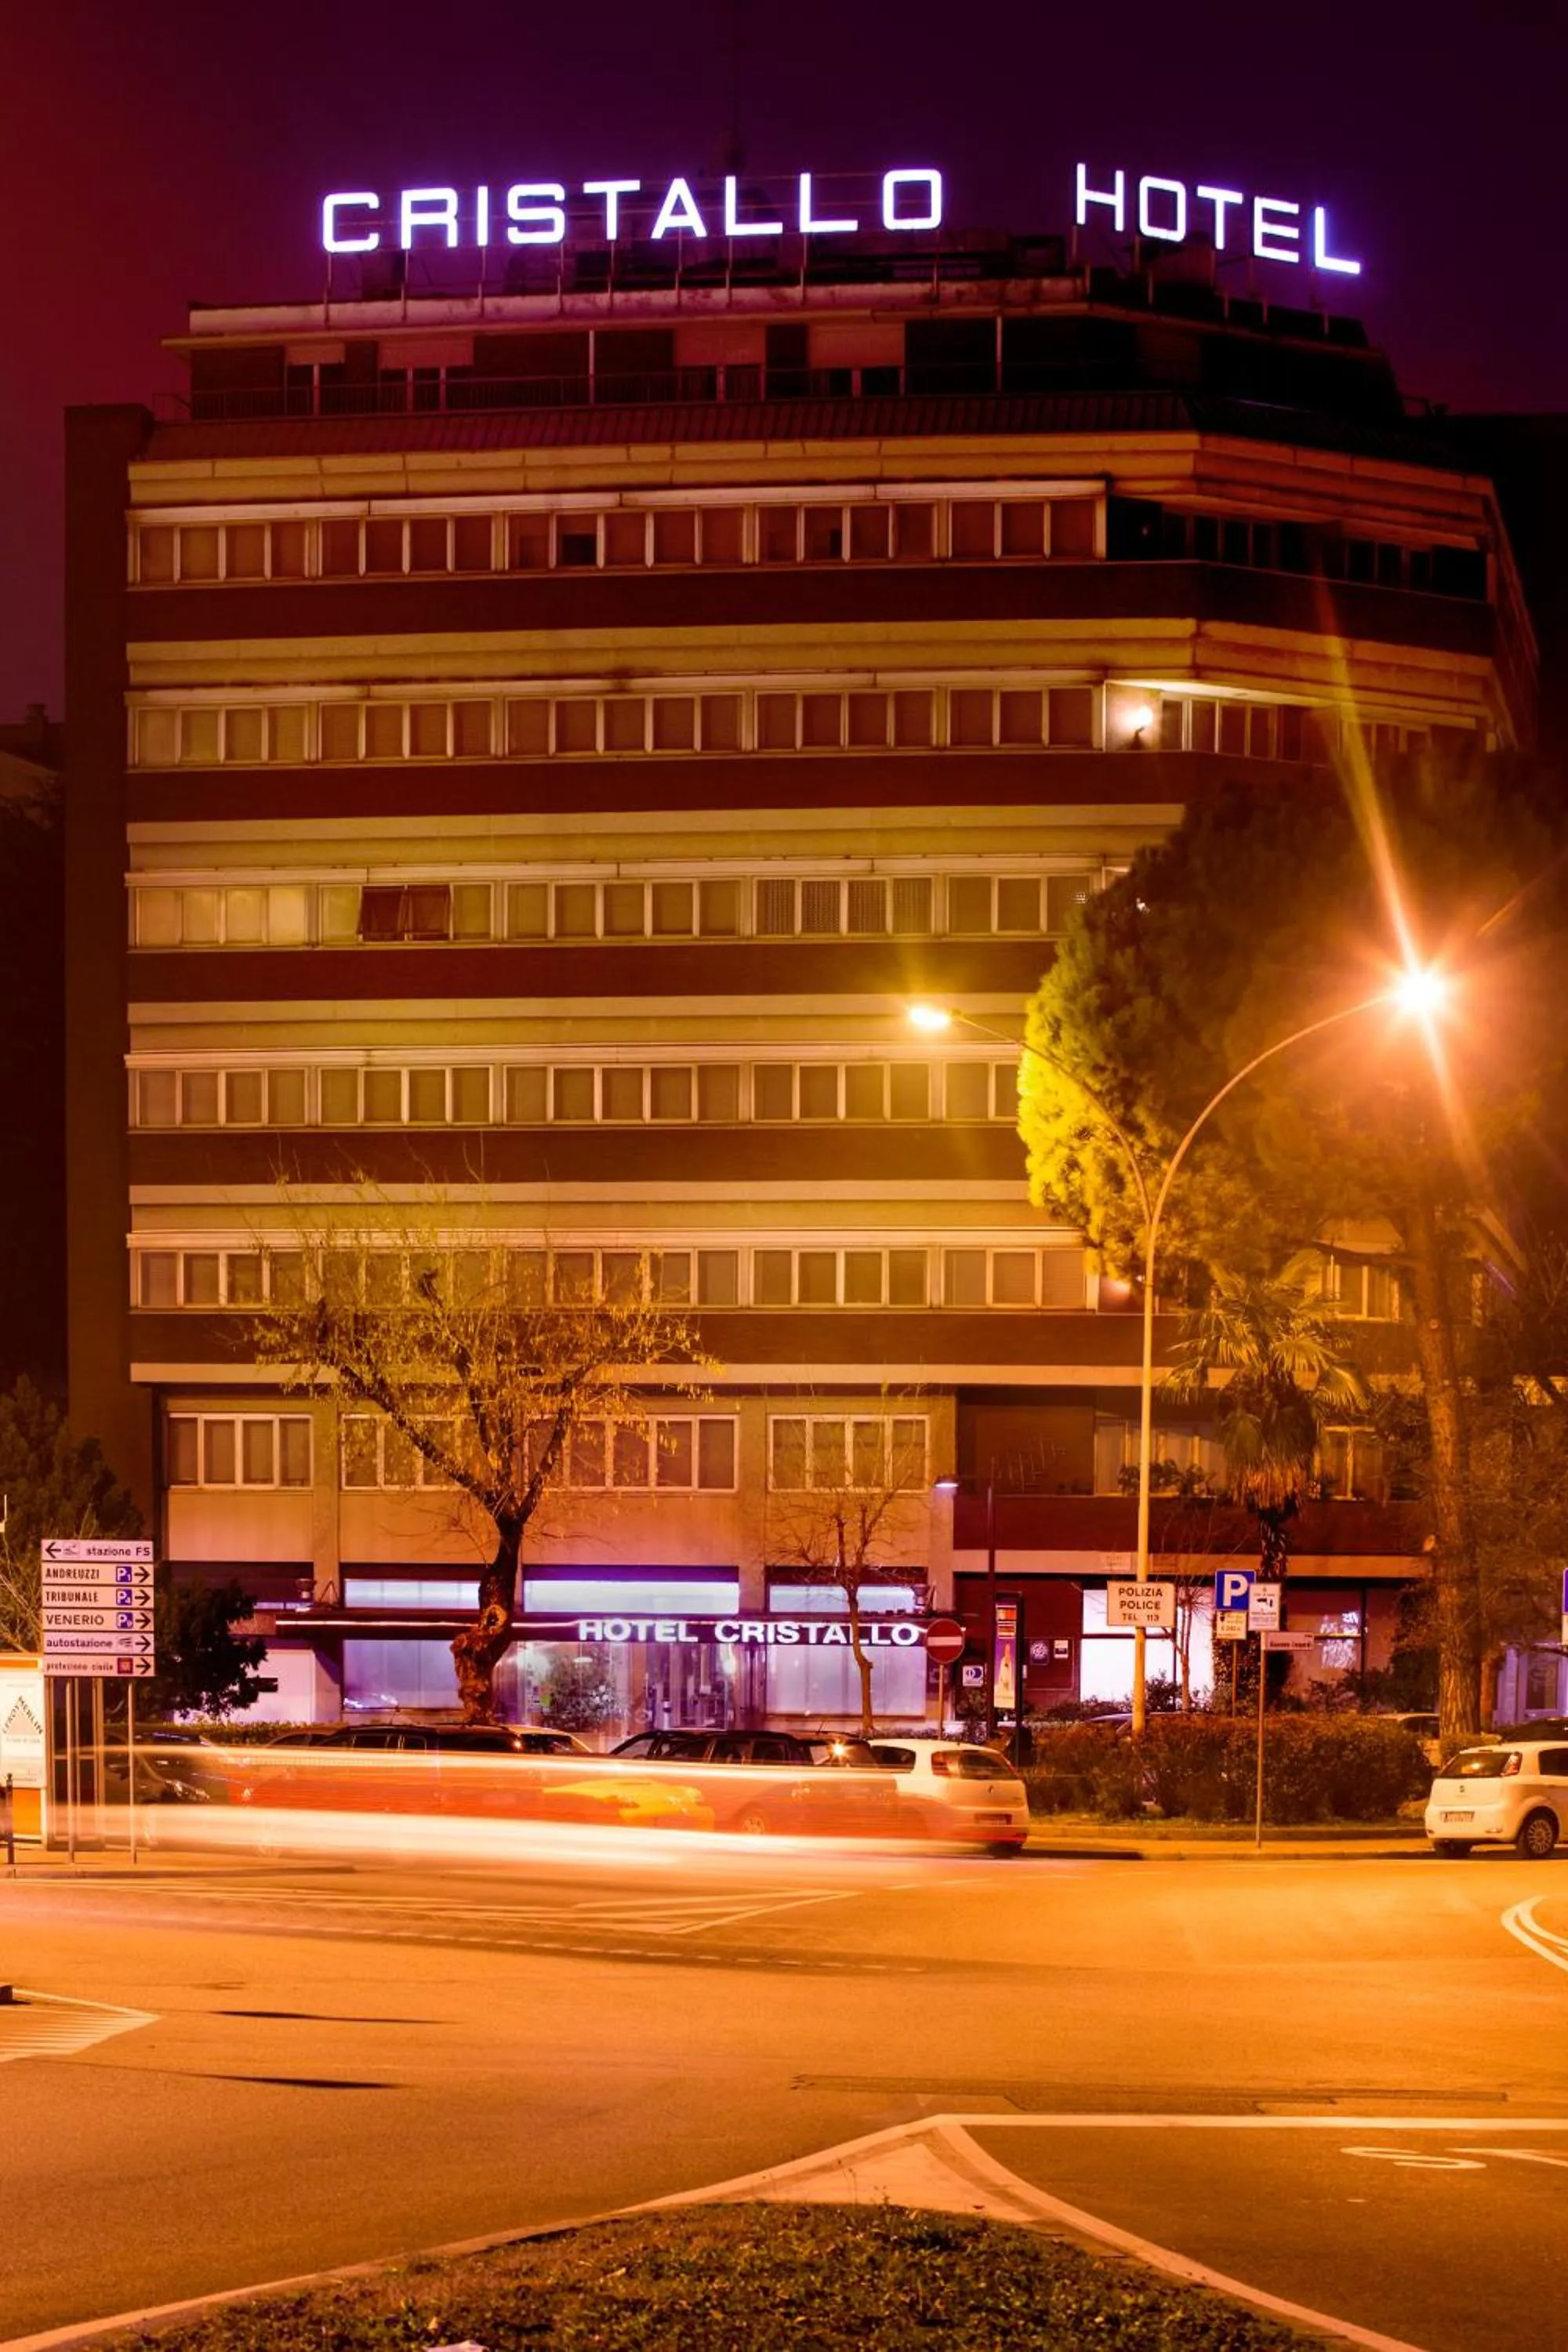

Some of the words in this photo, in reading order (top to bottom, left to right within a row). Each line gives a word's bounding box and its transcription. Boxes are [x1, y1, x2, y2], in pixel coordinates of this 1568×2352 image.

[322, 168, 942, 252] CRISTALLO
[1076, 162, 1362, 274] HOTEL
[86, 1547, 131, 1556] stazione
[136, 1547, 151, 1556] FS
[45, 1568, 100, 1580] ANDREUZZI
[1118, 1587, 1163, 1597] POLIZIA
[1223, 1574, 1248, 1606] P
[46, 1592, 99, 1602] TRIBUNALE
[1120, 1600, 1161, 1610] POLICE
[46, 1614, 104, 1625] VENERIO
[578, 1619, 698, 1643] HOTEL
[714, 1620, 920, 1646] CRISTALLO
[46, 1638, 113, 1648] autostazione
[47, 1662, 88, 1671] protezione
